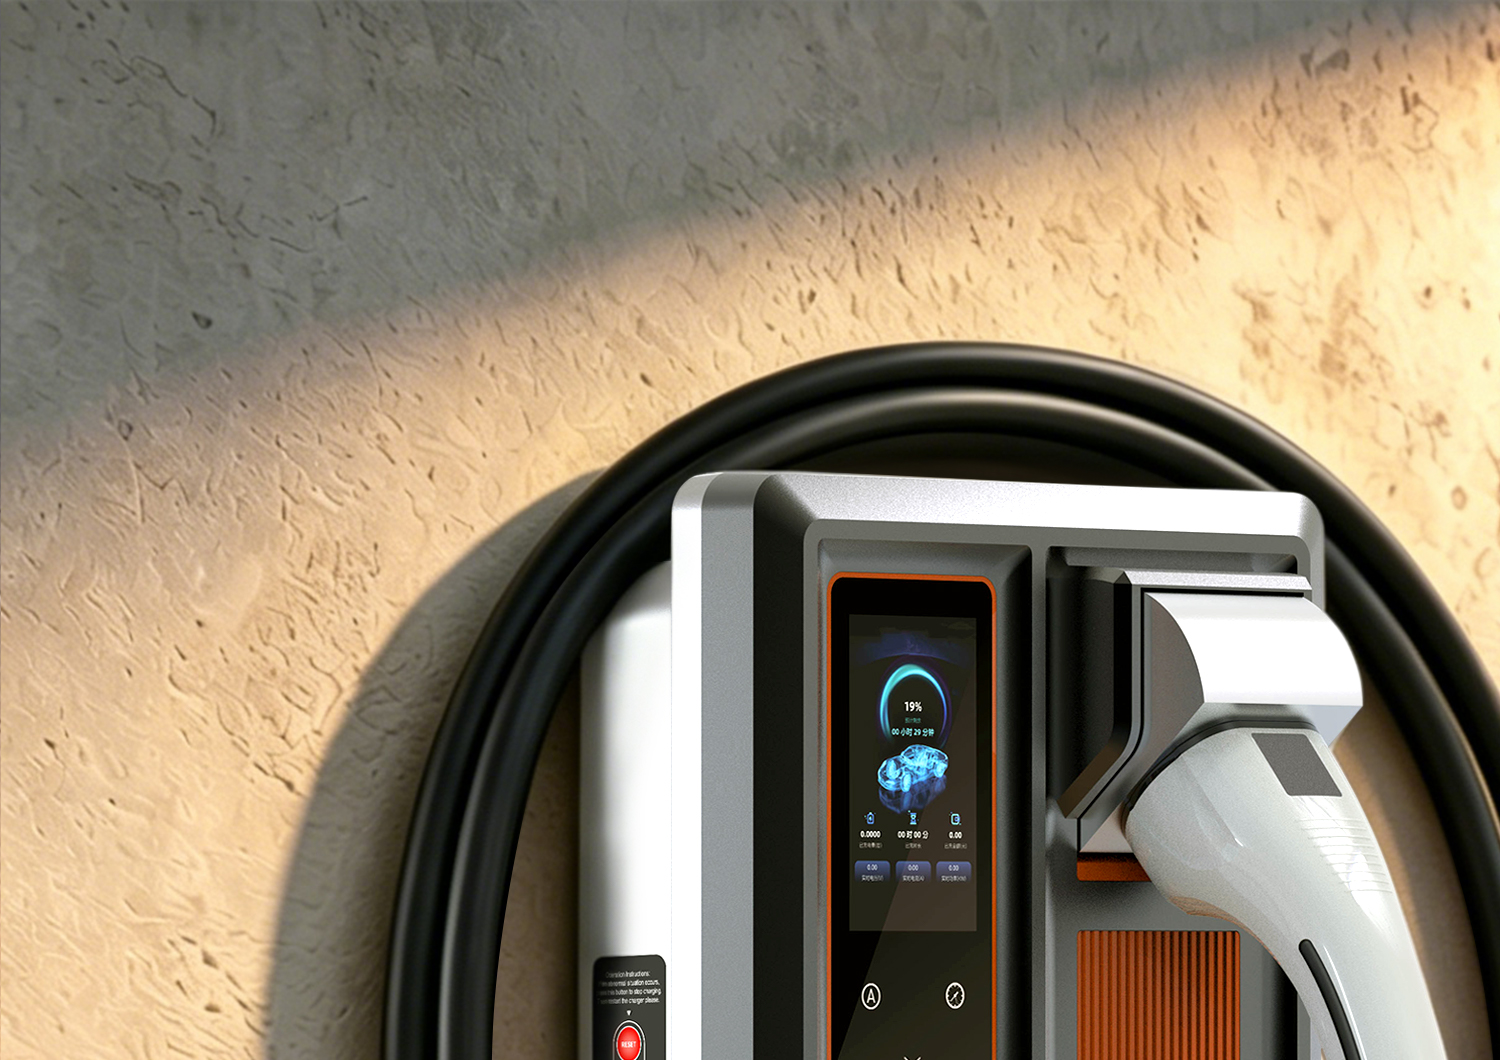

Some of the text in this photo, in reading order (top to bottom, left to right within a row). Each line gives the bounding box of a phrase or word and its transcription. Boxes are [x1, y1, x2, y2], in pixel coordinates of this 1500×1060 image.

[904, 701, 923, 712] 19%
[859, 830, 881, 838] 0.0000
[948, 831, 963, 839] 0.00
